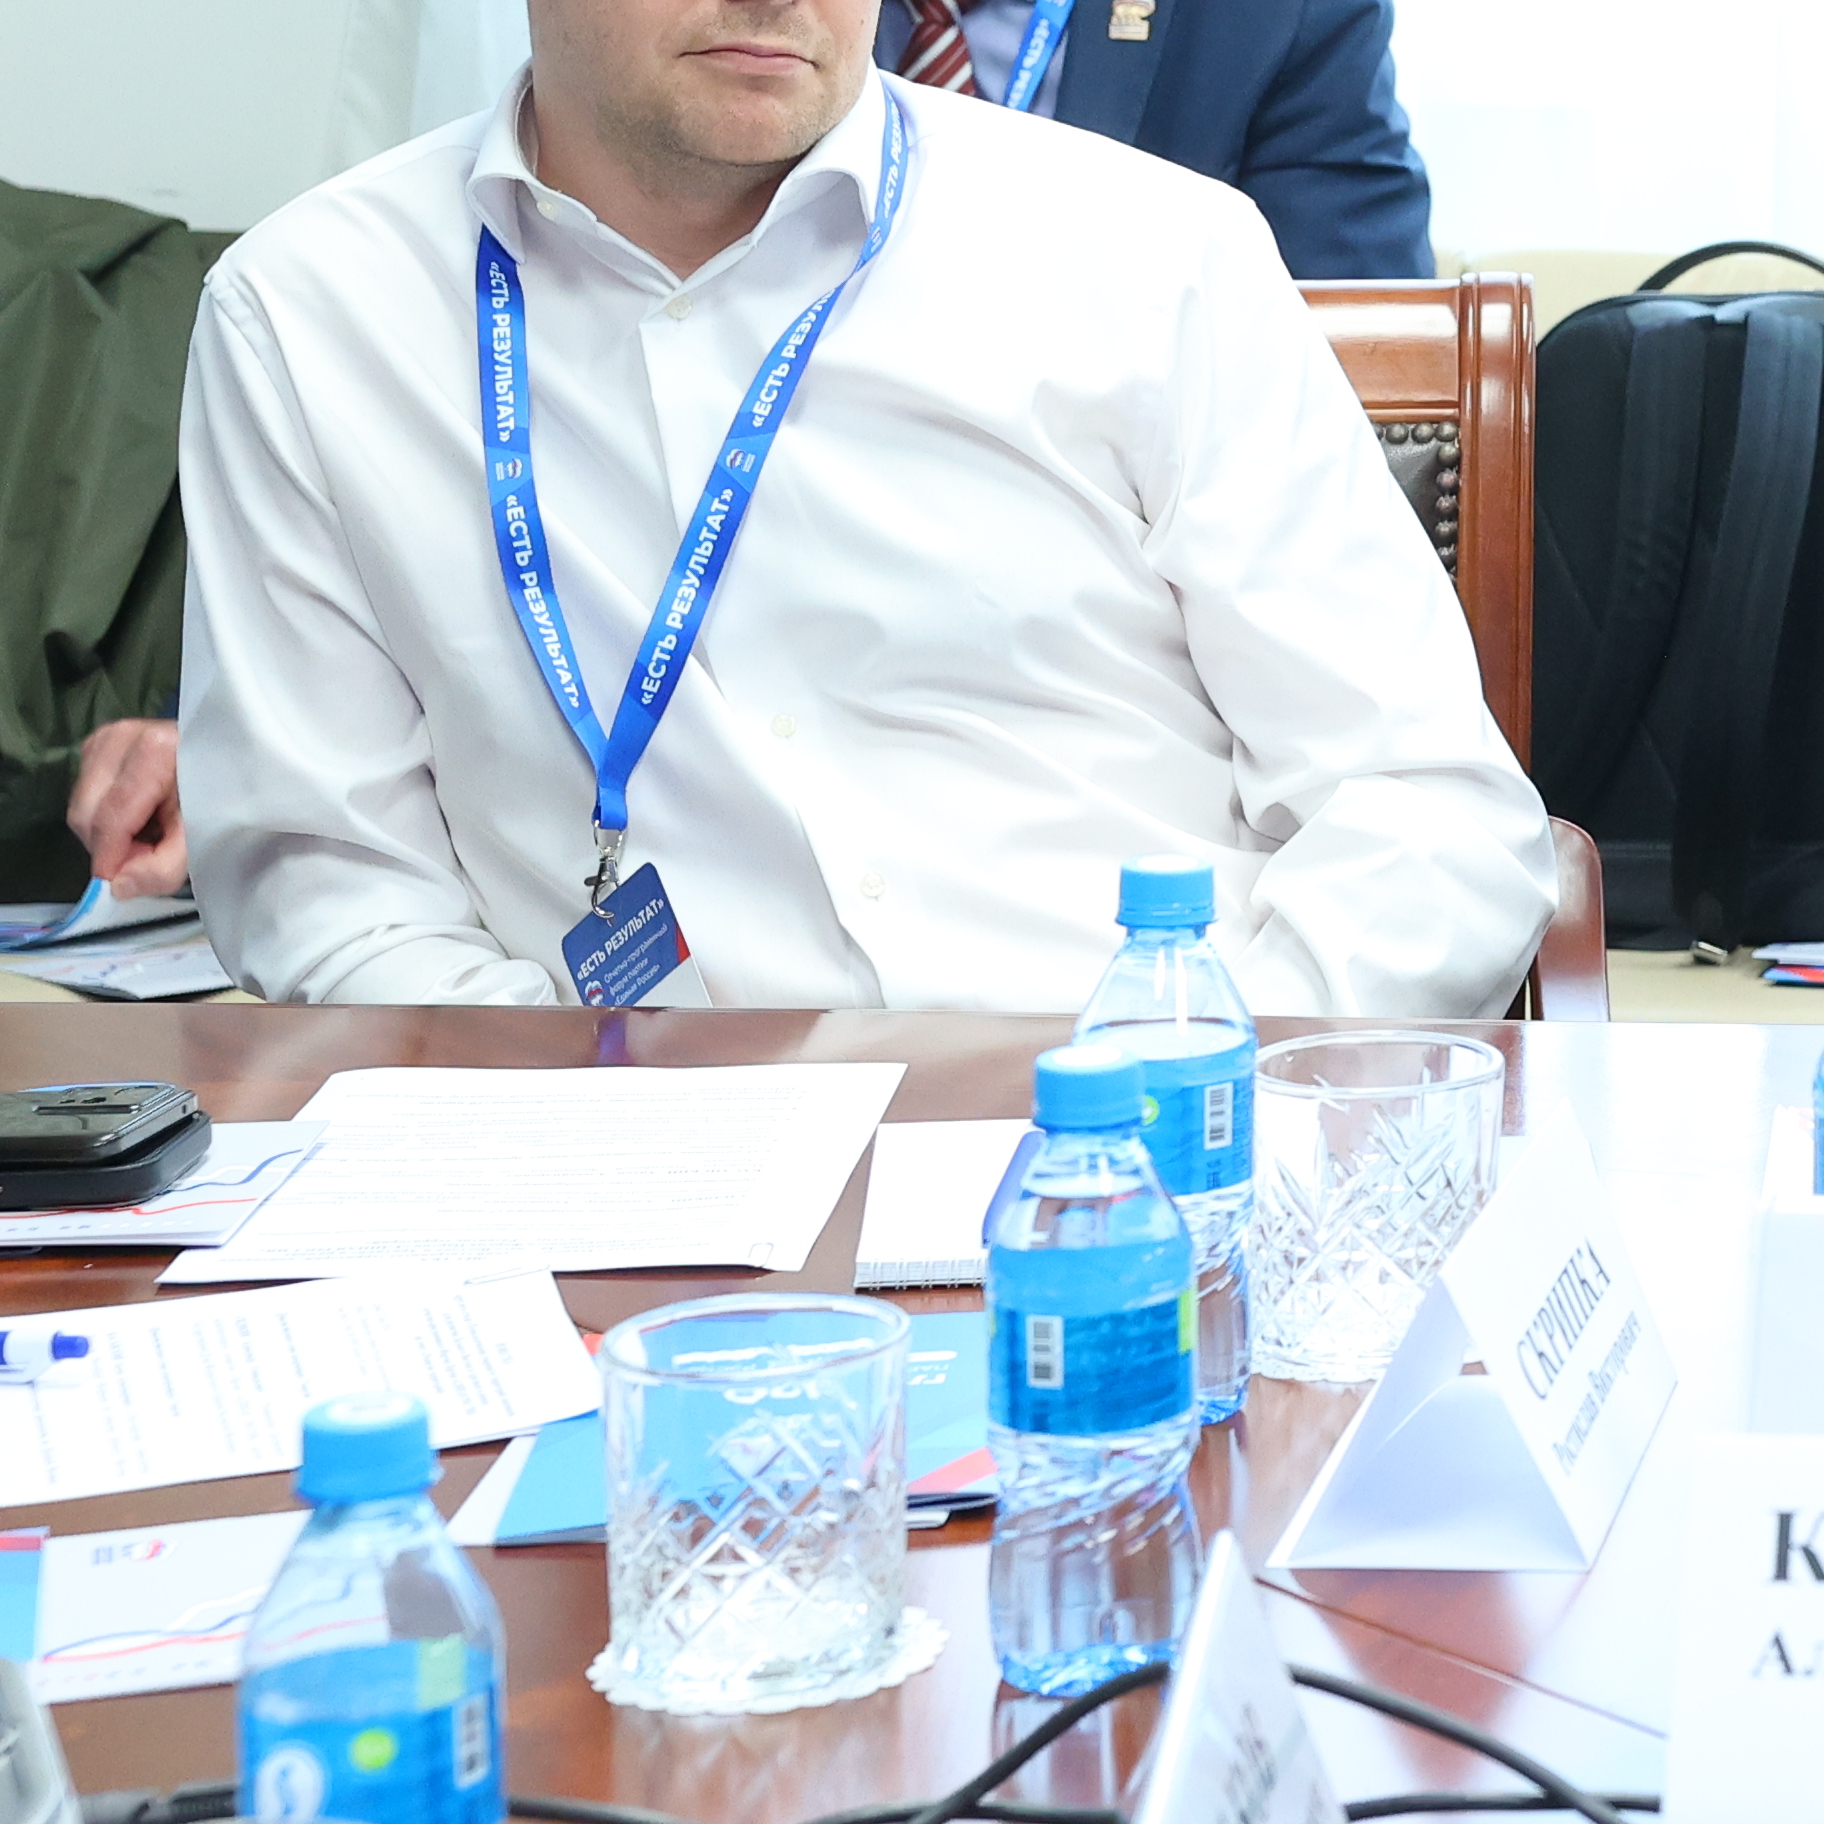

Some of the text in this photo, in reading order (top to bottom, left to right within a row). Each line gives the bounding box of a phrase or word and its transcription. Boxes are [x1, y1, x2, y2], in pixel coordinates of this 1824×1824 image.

[489, 261, 516, 443] «ЕСТЬ РЕЗУЛЬТАТ»
[751, 357, 791, 429] «ЕСТЬ
[506, 494, 581, 709] «ЕСТЬ РЕЗУЛЬТАТ»
[641, 487, 734, 706] «ЕСТЬ РЕЗУЛЬТАТ»
[577, 898, 665, 981] «ЕСТЬ РЕЗУЛЬТАТ»
[1516, 1235, 1612, 1402] СКРИПКА
